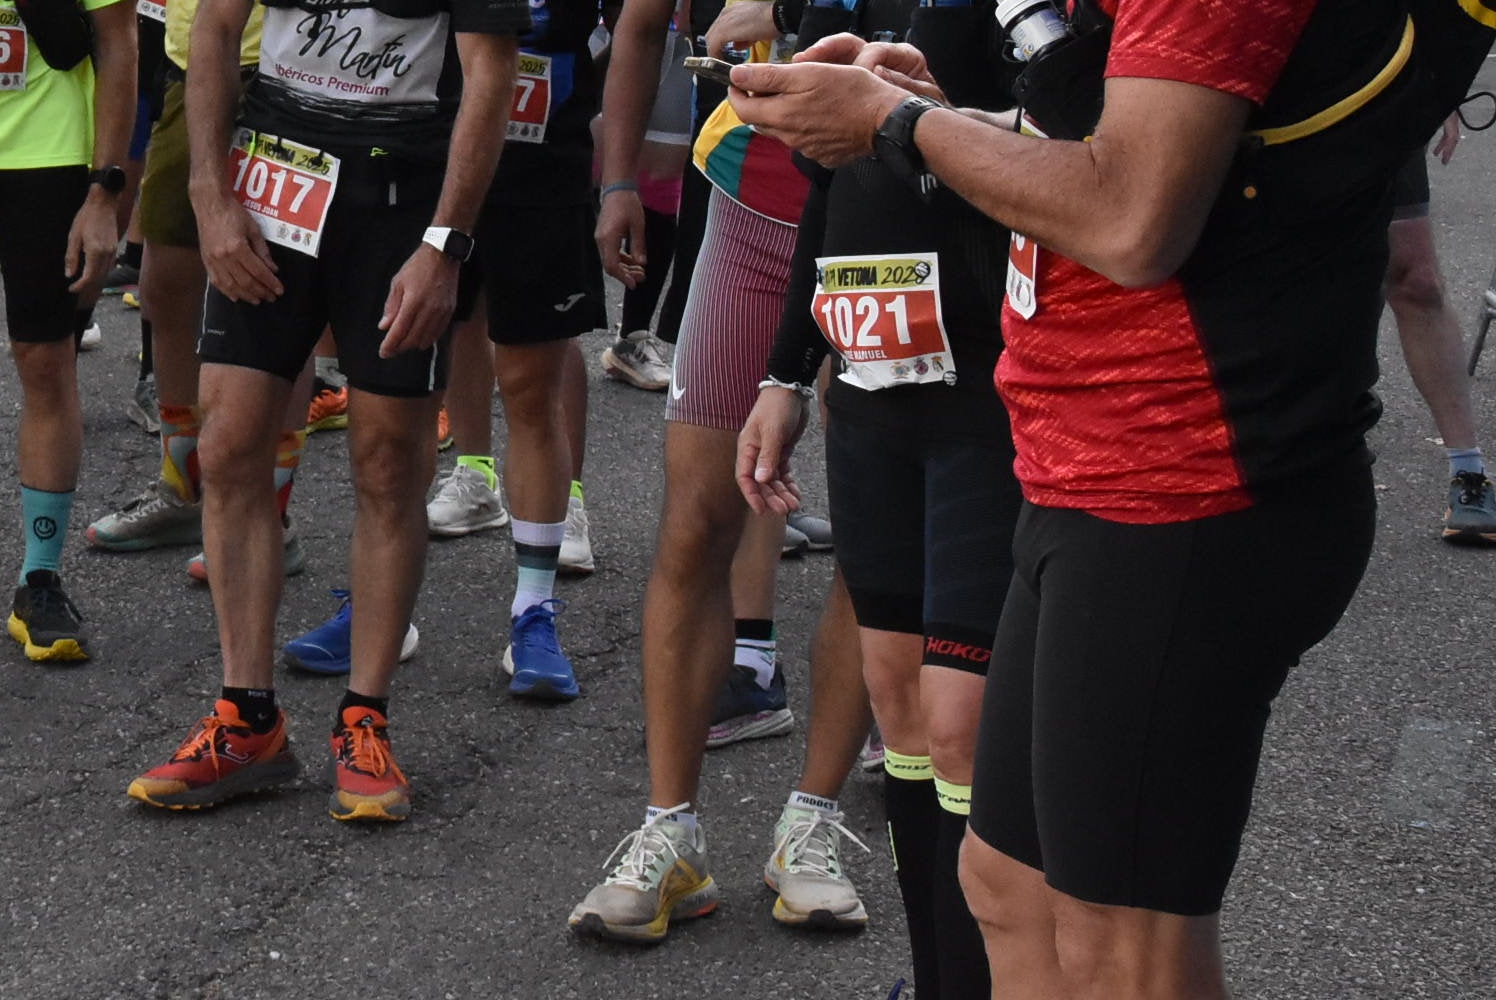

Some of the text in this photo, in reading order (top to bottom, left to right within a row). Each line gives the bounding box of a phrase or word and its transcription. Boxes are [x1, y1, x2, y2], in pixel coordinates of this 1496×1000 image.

[327, 76, 390, 97] Premium
[233, 156, 315, 214] 1017
[821, 294, 912, 348] 1021
